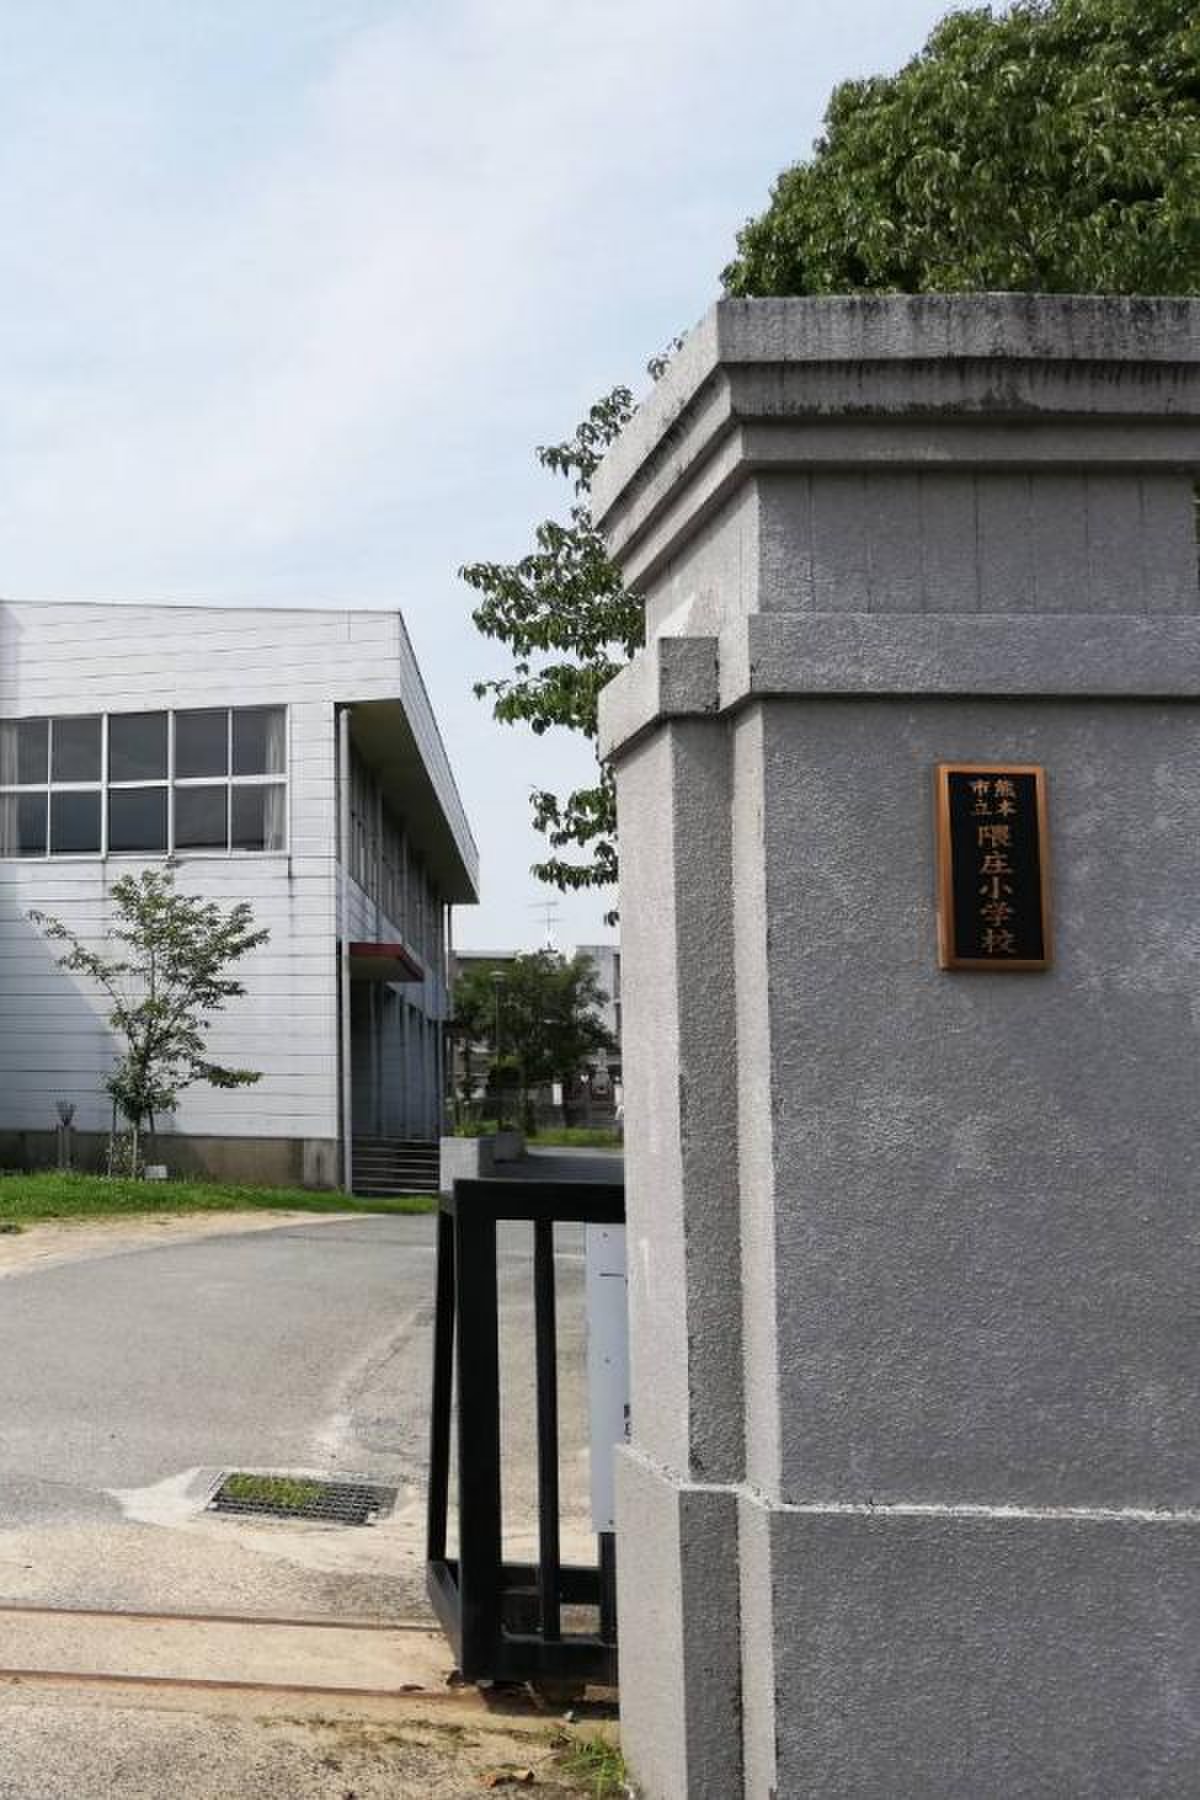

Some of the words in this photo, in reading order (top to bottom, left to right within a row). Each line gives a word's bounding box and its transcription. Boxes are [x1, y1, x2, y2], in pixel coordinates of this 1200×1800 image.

[977, 824, 1015, 954] 隈庄小学校
